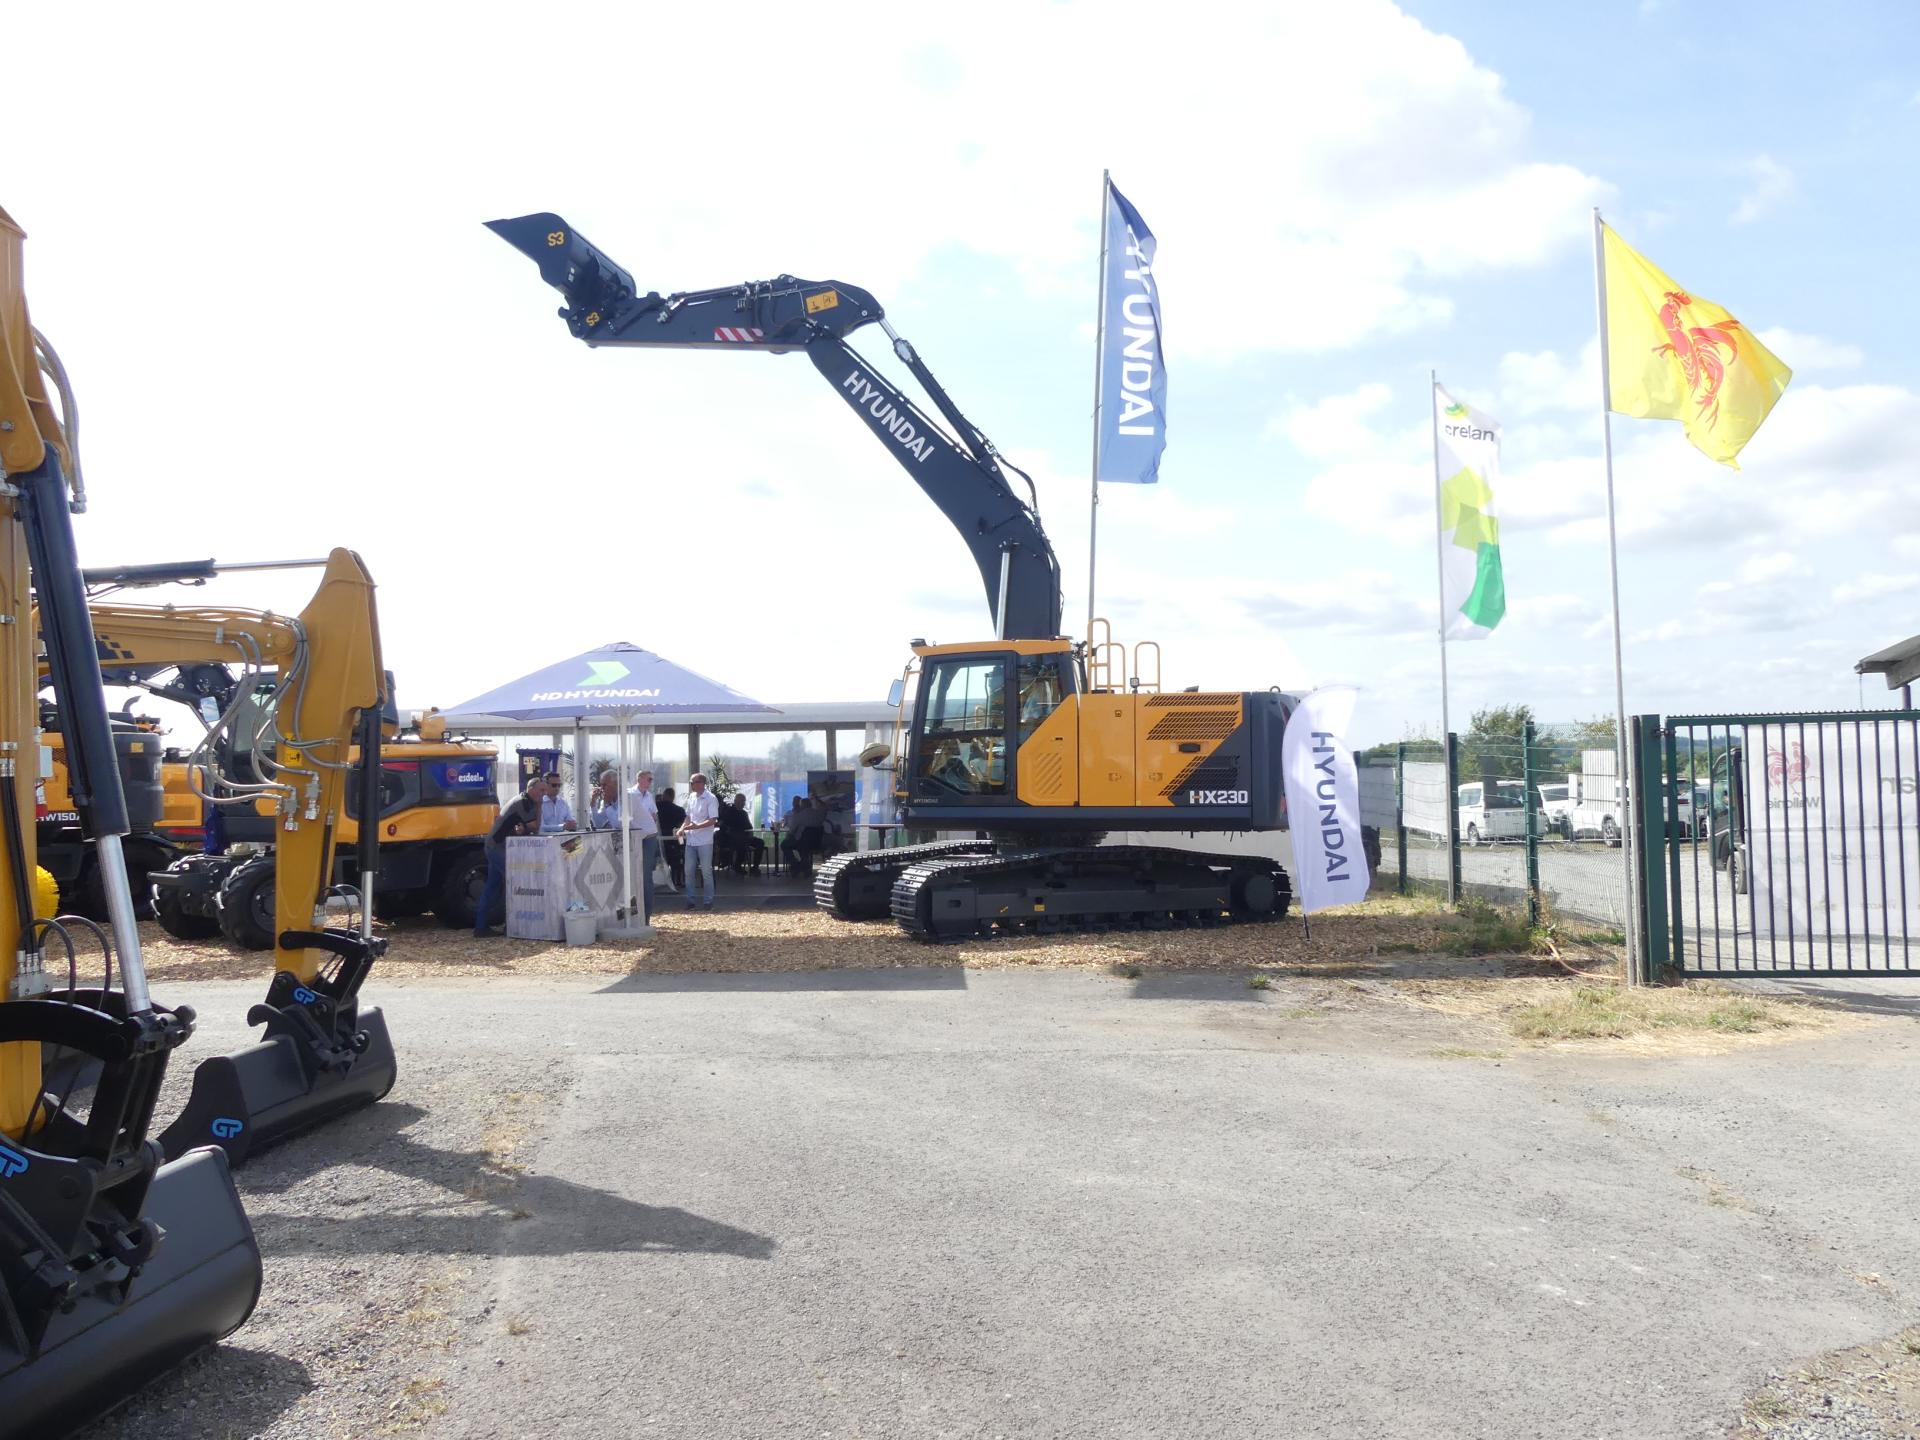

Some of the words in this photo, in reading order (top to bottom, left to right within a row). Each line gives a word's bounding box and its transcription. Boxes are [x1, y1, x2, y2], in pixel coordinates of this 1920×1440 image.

[547, 231, 564, 246] S3
[842, 370, 935, 462] HYUNDAI
[1445, 424, 1495, 442] crelan
[1189, 790, 1249, 804] HX230
[1310, 731, 1350, 882] HYUNDAI
[212, 1117, 243, 1138] GP
